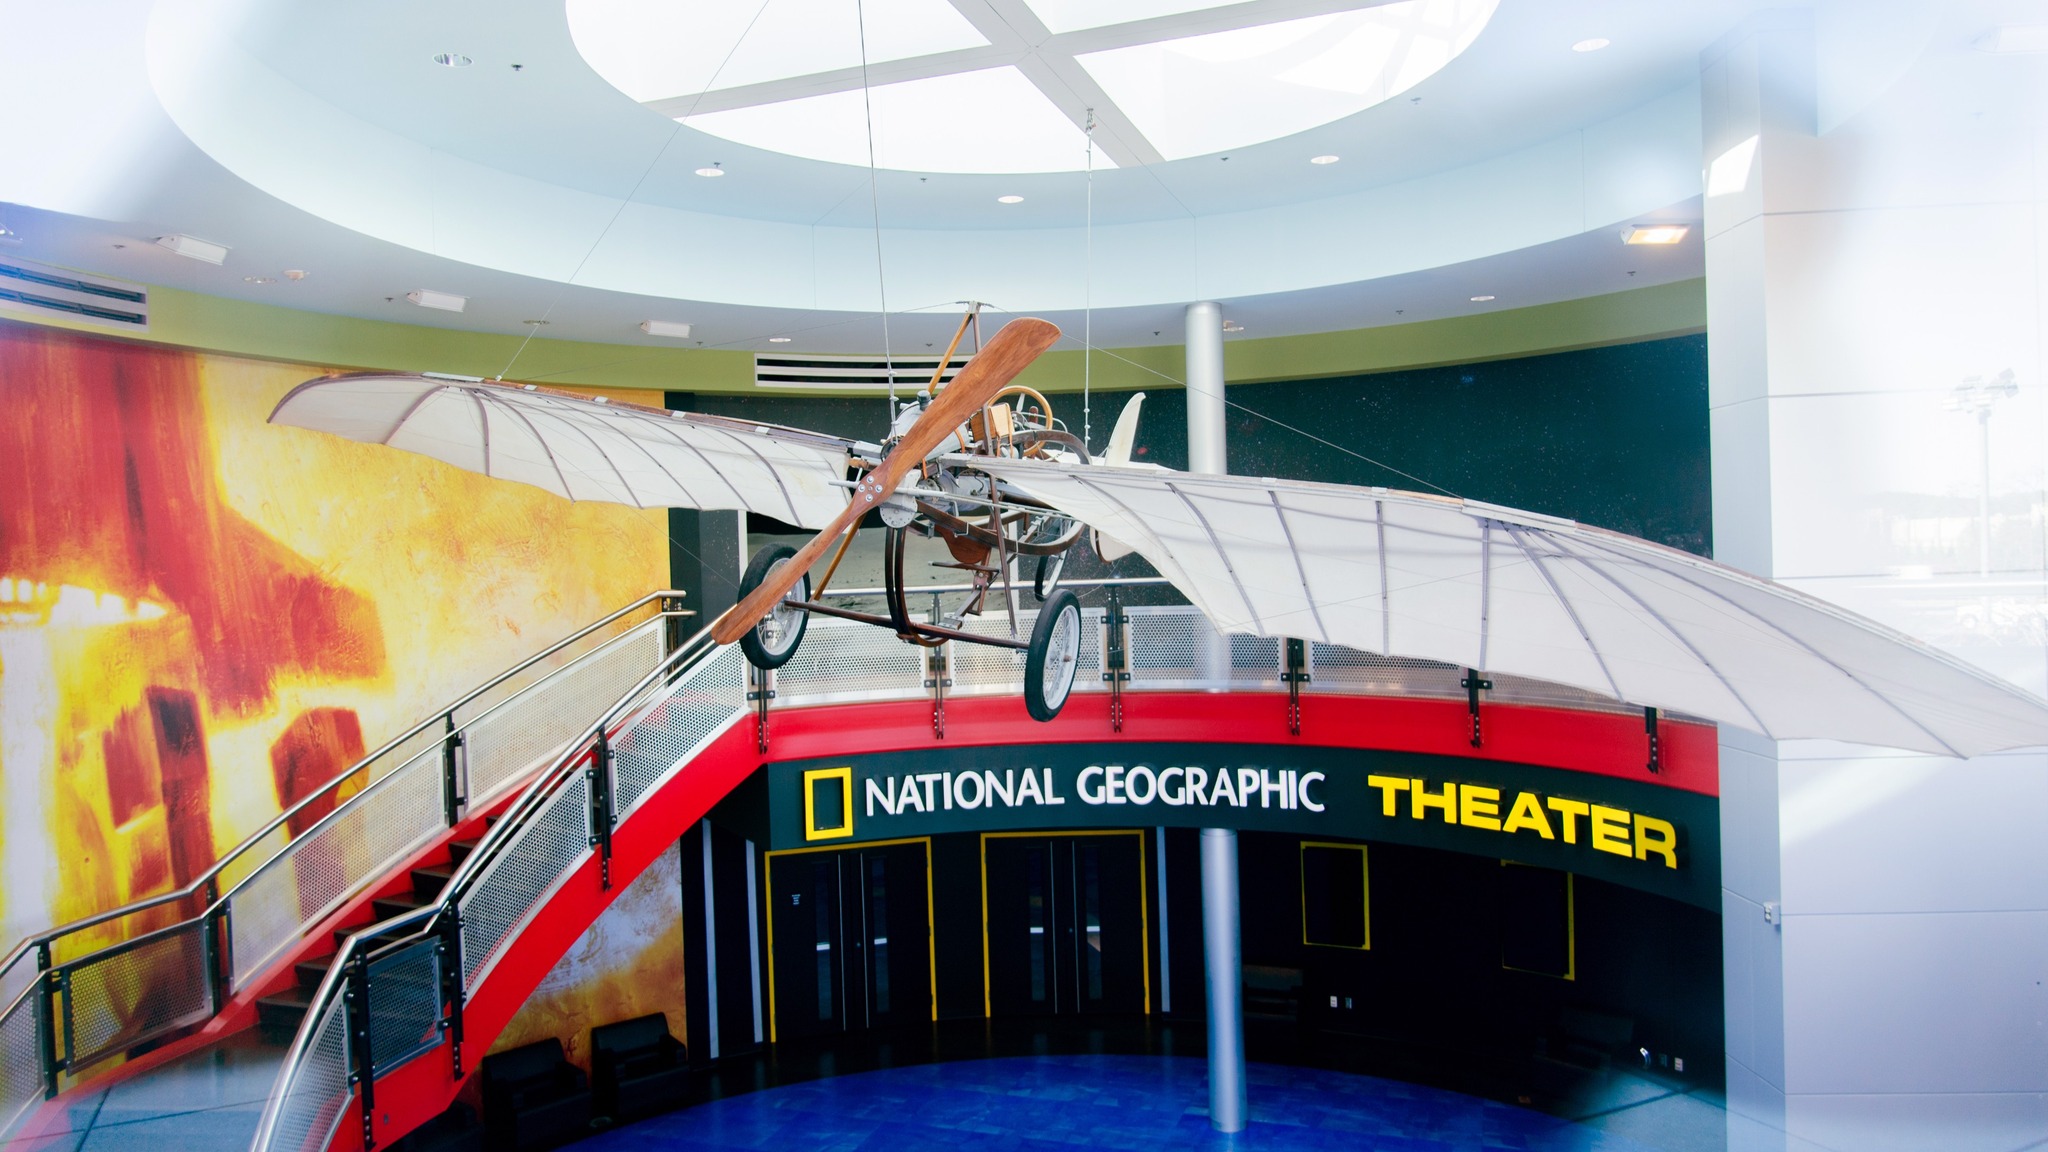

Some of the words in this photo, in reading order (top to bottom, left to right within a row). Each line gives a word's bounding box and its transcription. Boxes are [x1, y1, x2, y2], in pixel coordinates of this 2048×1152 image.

[865, 767, 1065, 817] NATIONAL
[1076, 765, 1326, 813] GEOGRAPHIC
[1367, 774, 1677, 869] THEATER
